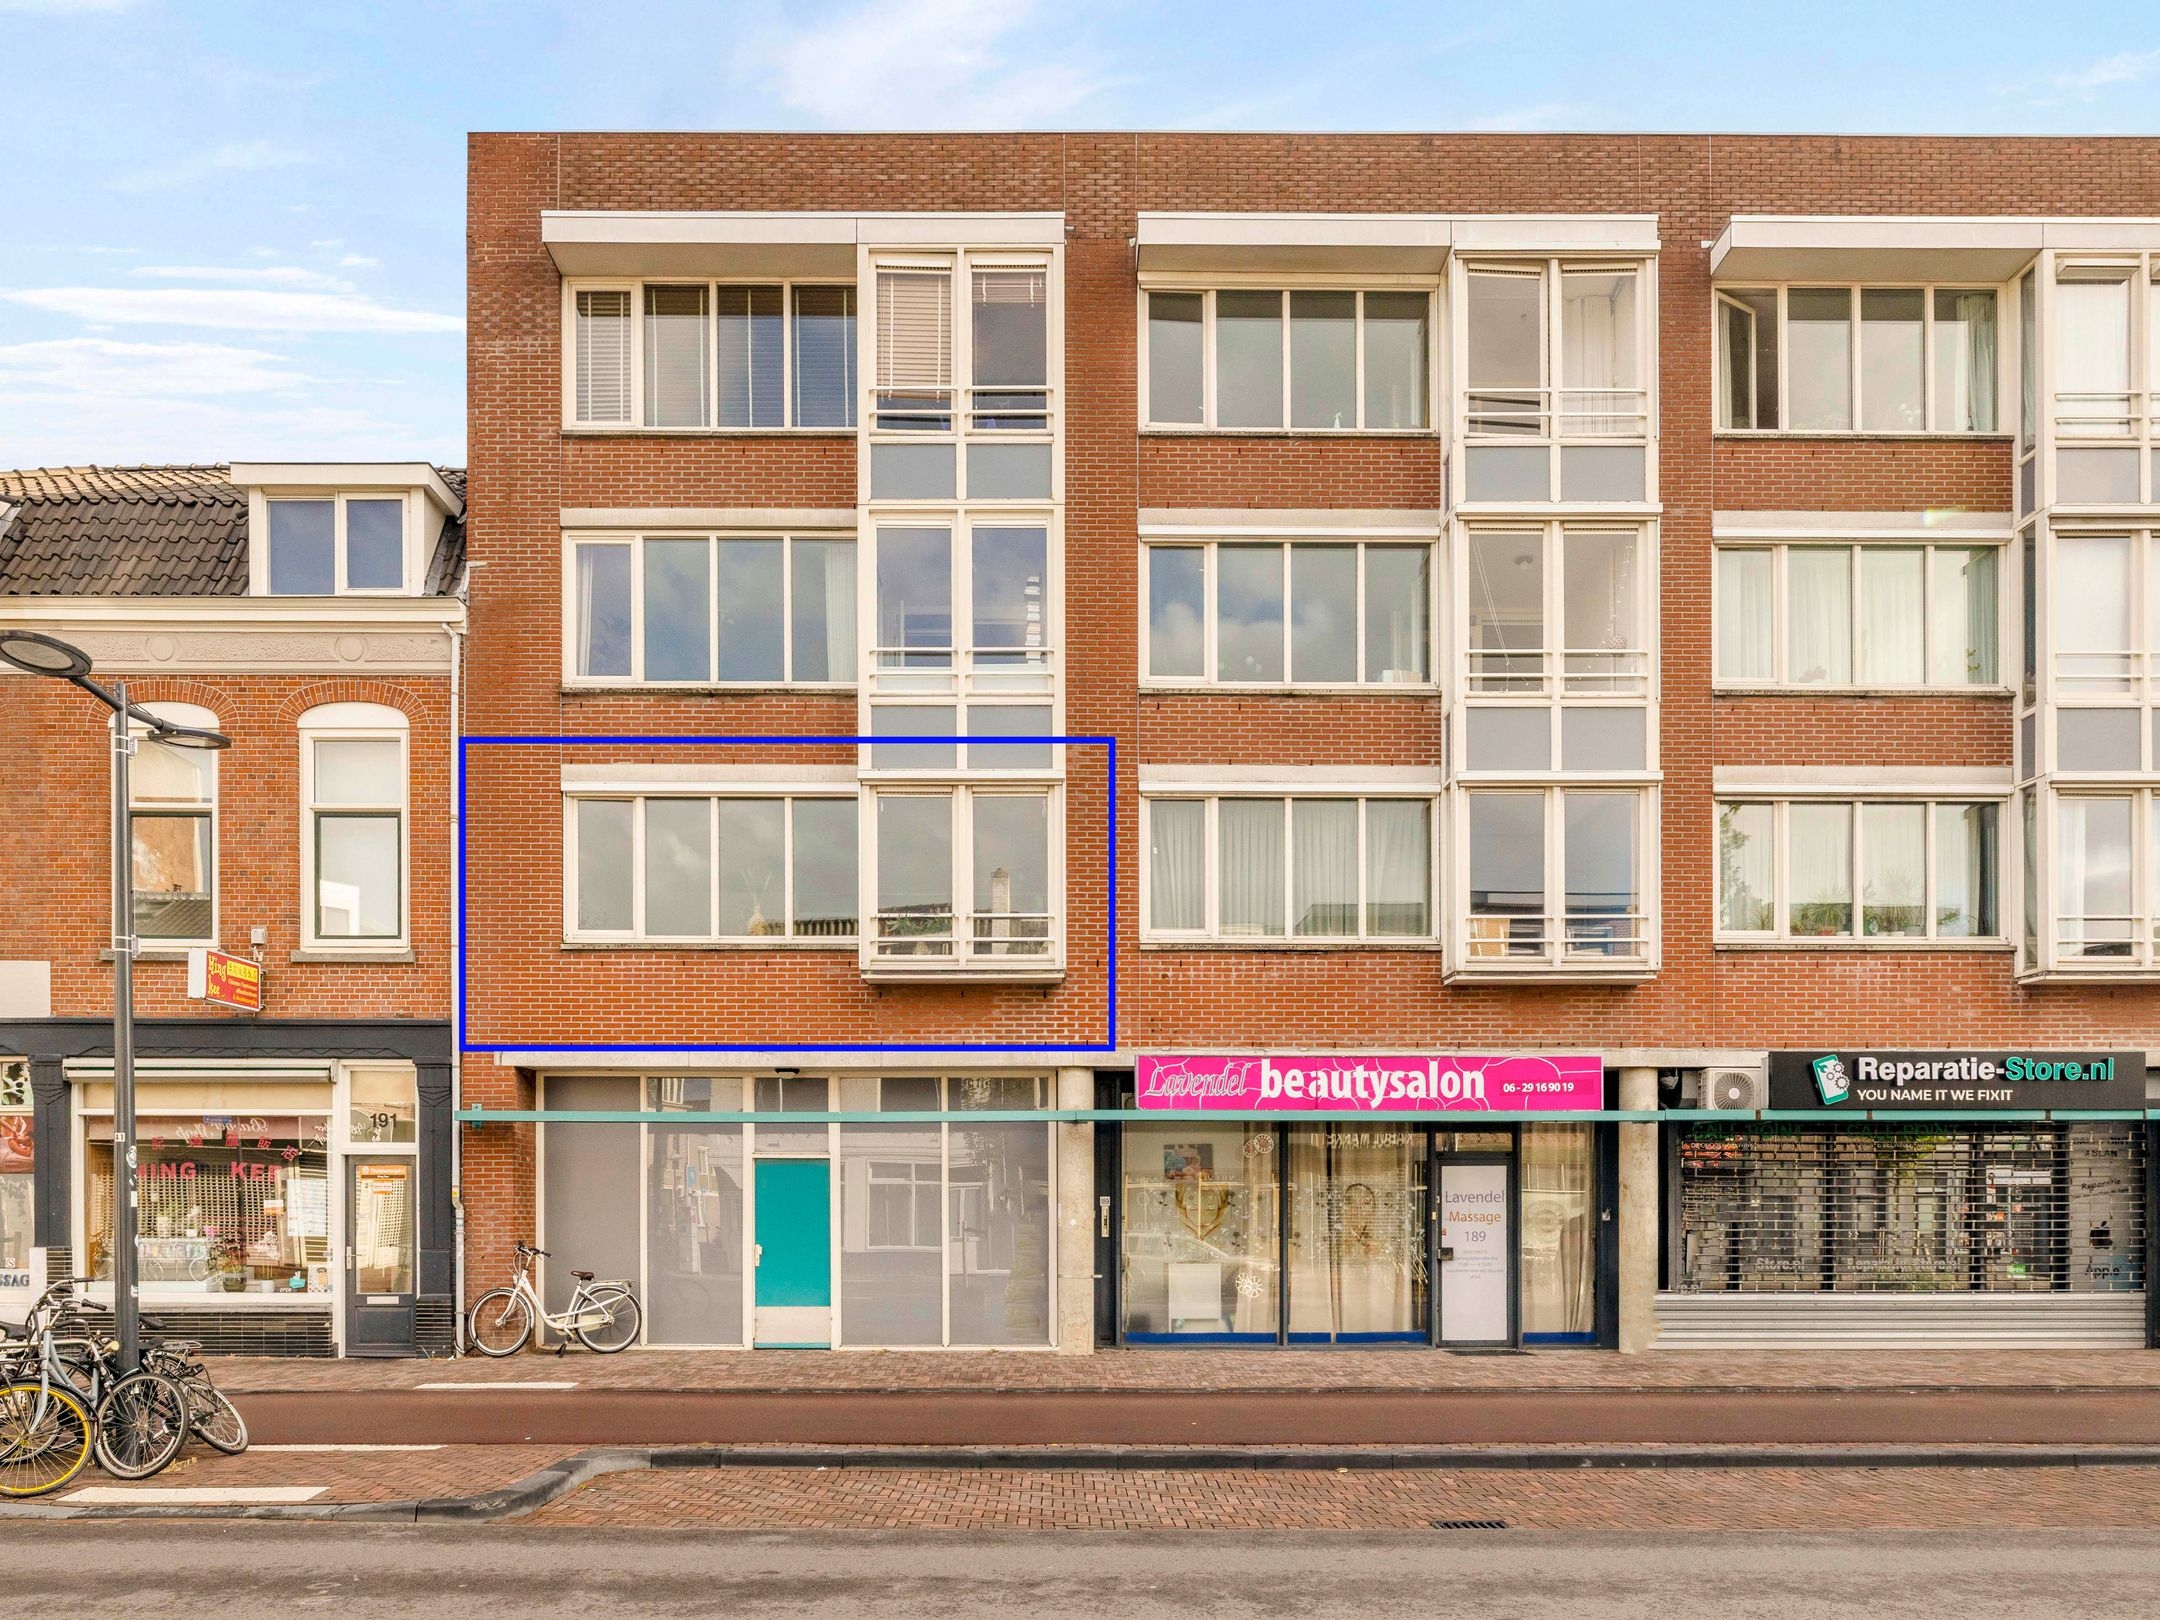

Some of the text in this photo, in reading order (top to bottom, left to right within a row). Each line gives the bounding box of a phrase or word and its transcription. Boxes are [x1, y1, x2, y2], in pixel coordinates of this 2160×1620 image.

[1858, 1056, 2114, 1086] Reparatie-Store.nl
[1146, 1058, 1484, 1108] Lavendel beautysalon
[1503, 1082, 1516, 1093] 06
[1521, 1082, 1534, 1093] 29
[1535, 1082, 1547, 1093] 16
[1548, 1082, 1561, 1093] 90
[1562, 1082, 1574, 1093] 19
[1857, 1089, 1887, 1101] YOU
[1891, 1089, 1932, 1101] NAME
[1935, 1089, 1948, 1101] IT
[1950, 1089, 1974, 1101] WE
[370, 1113, 397, 1128] 191
[1445, 1190, 1505, 1203] Lavendel
[1449, 1211, 1501, 1225] Massage
[1465, 1231, 1487, 1242] 189
